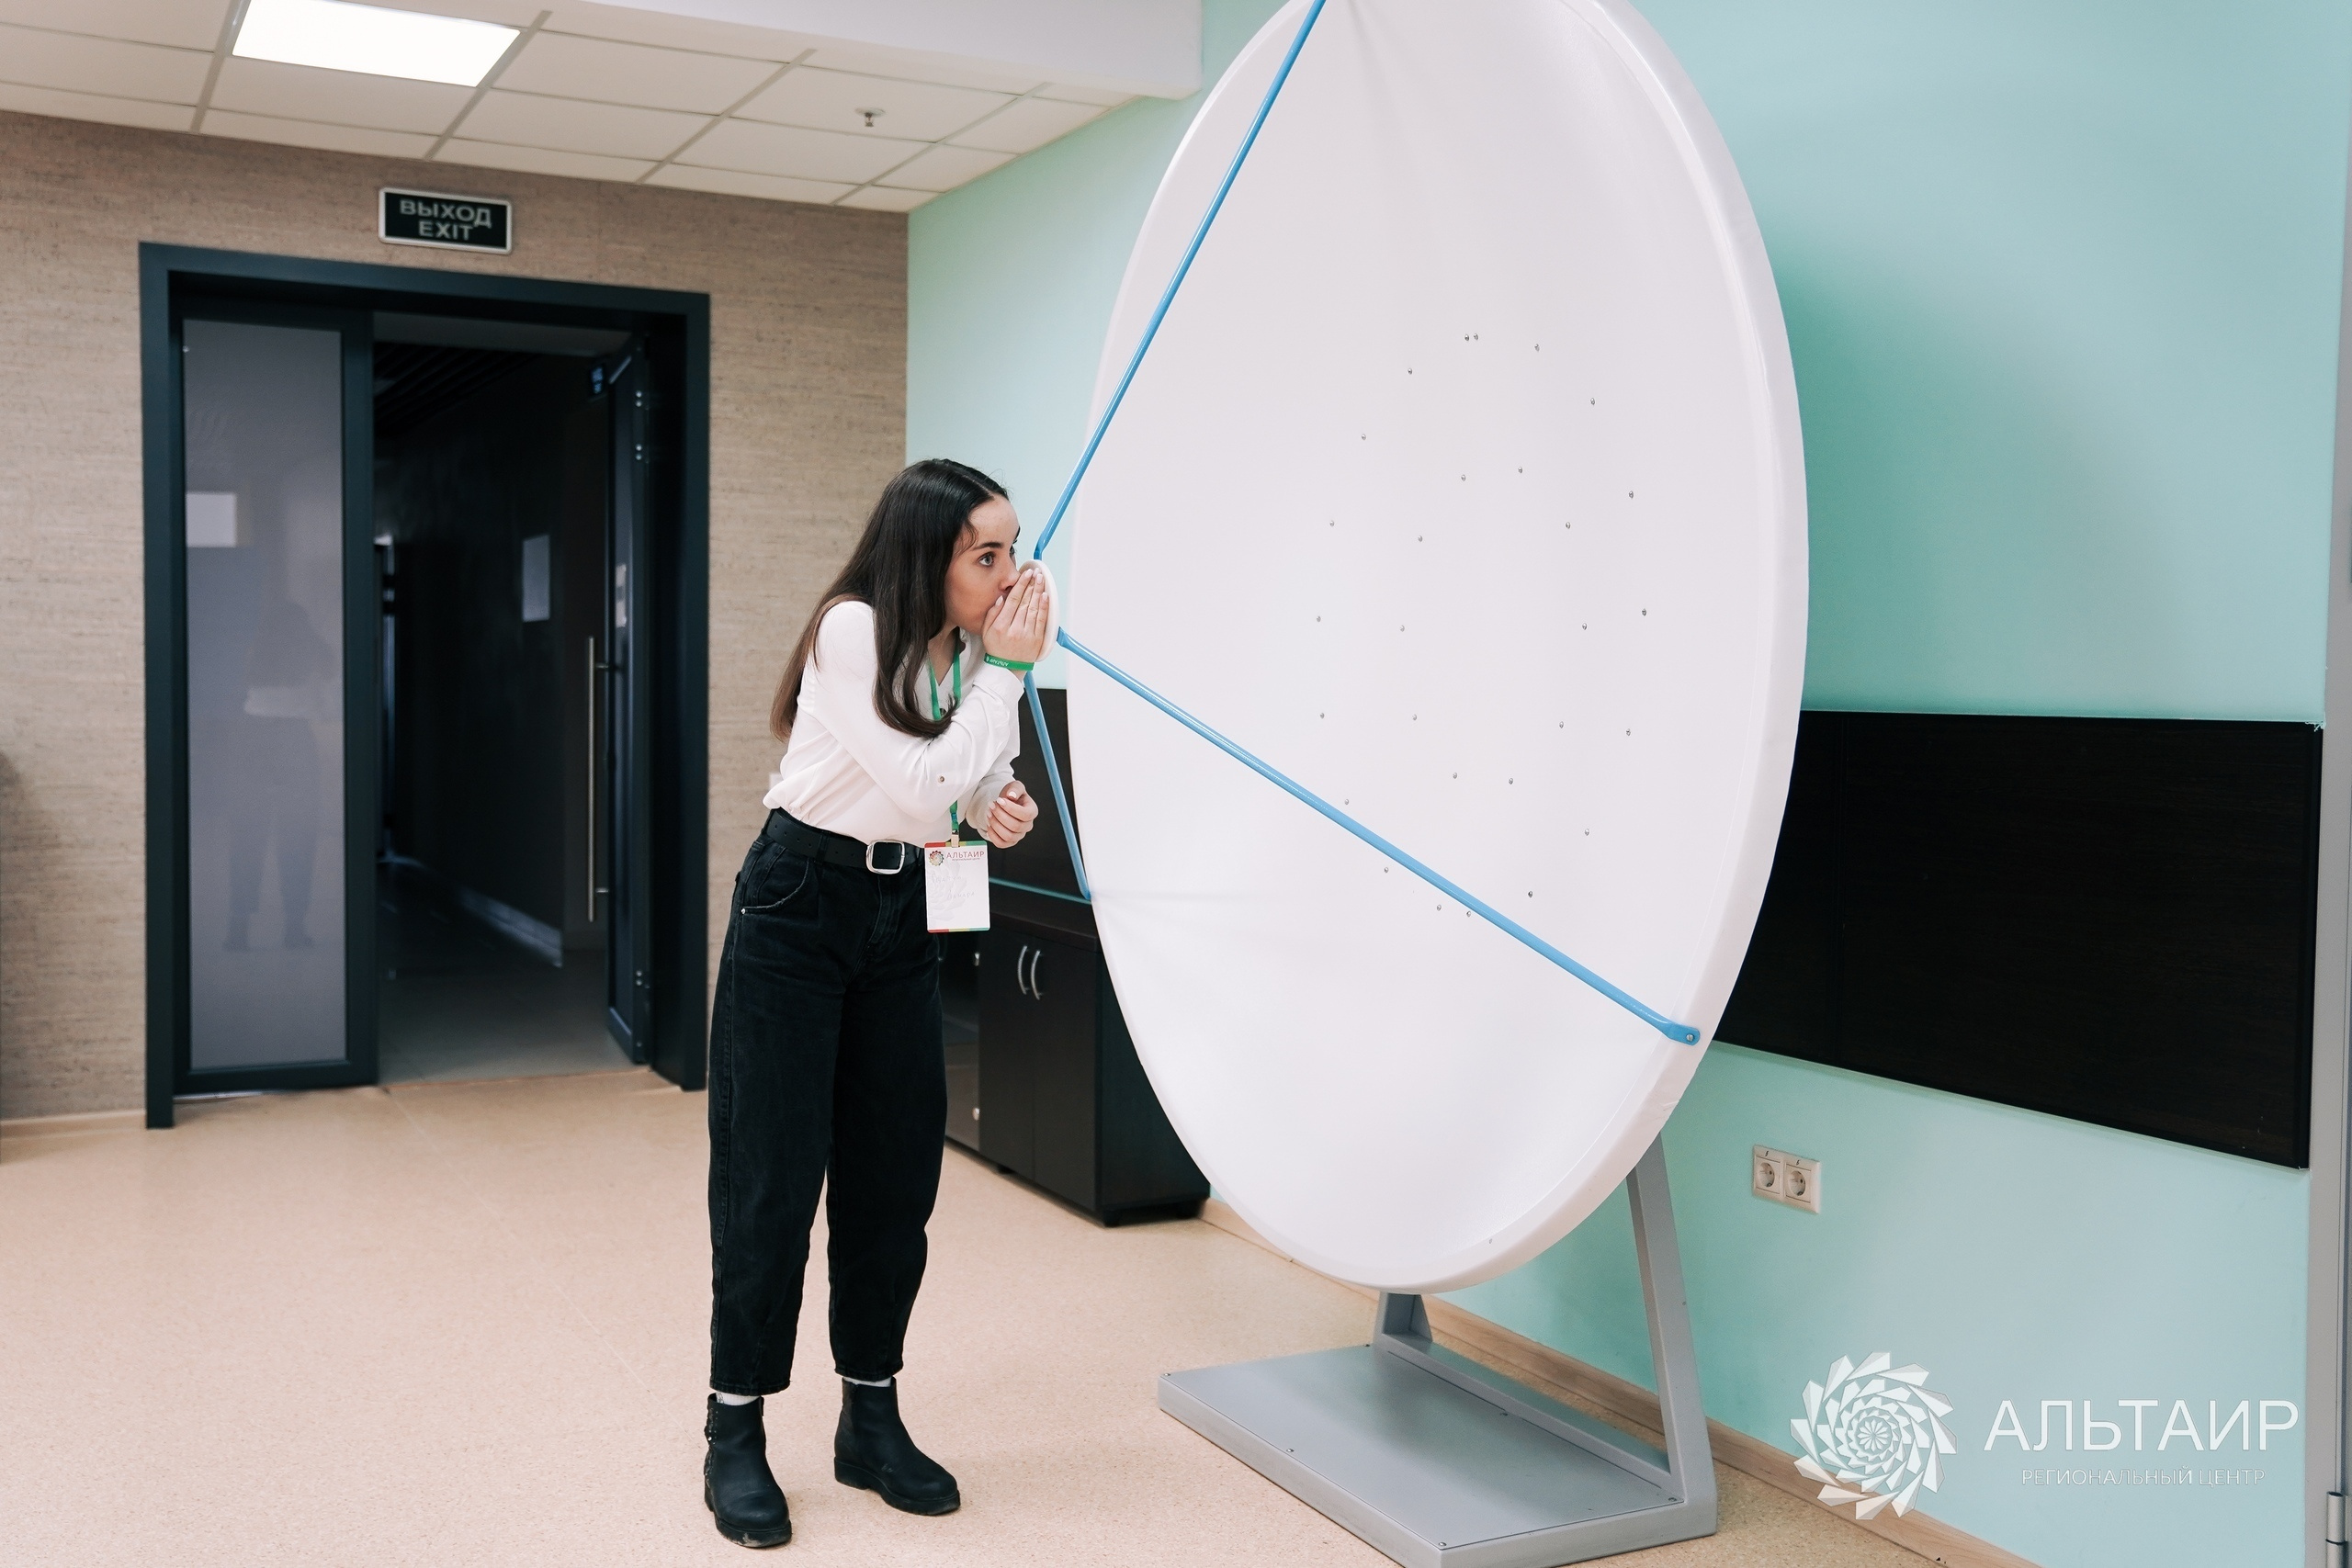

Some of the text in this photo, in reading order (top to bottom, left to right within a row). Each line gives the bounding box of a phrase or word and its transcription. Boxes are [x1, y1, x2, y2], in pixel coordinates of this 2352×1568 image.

[400, 199, 492, 229] ВЫХОД
[418, 220, 473, 241] EXIT
[946, 851, 985, 859] АЛЬТАИР
